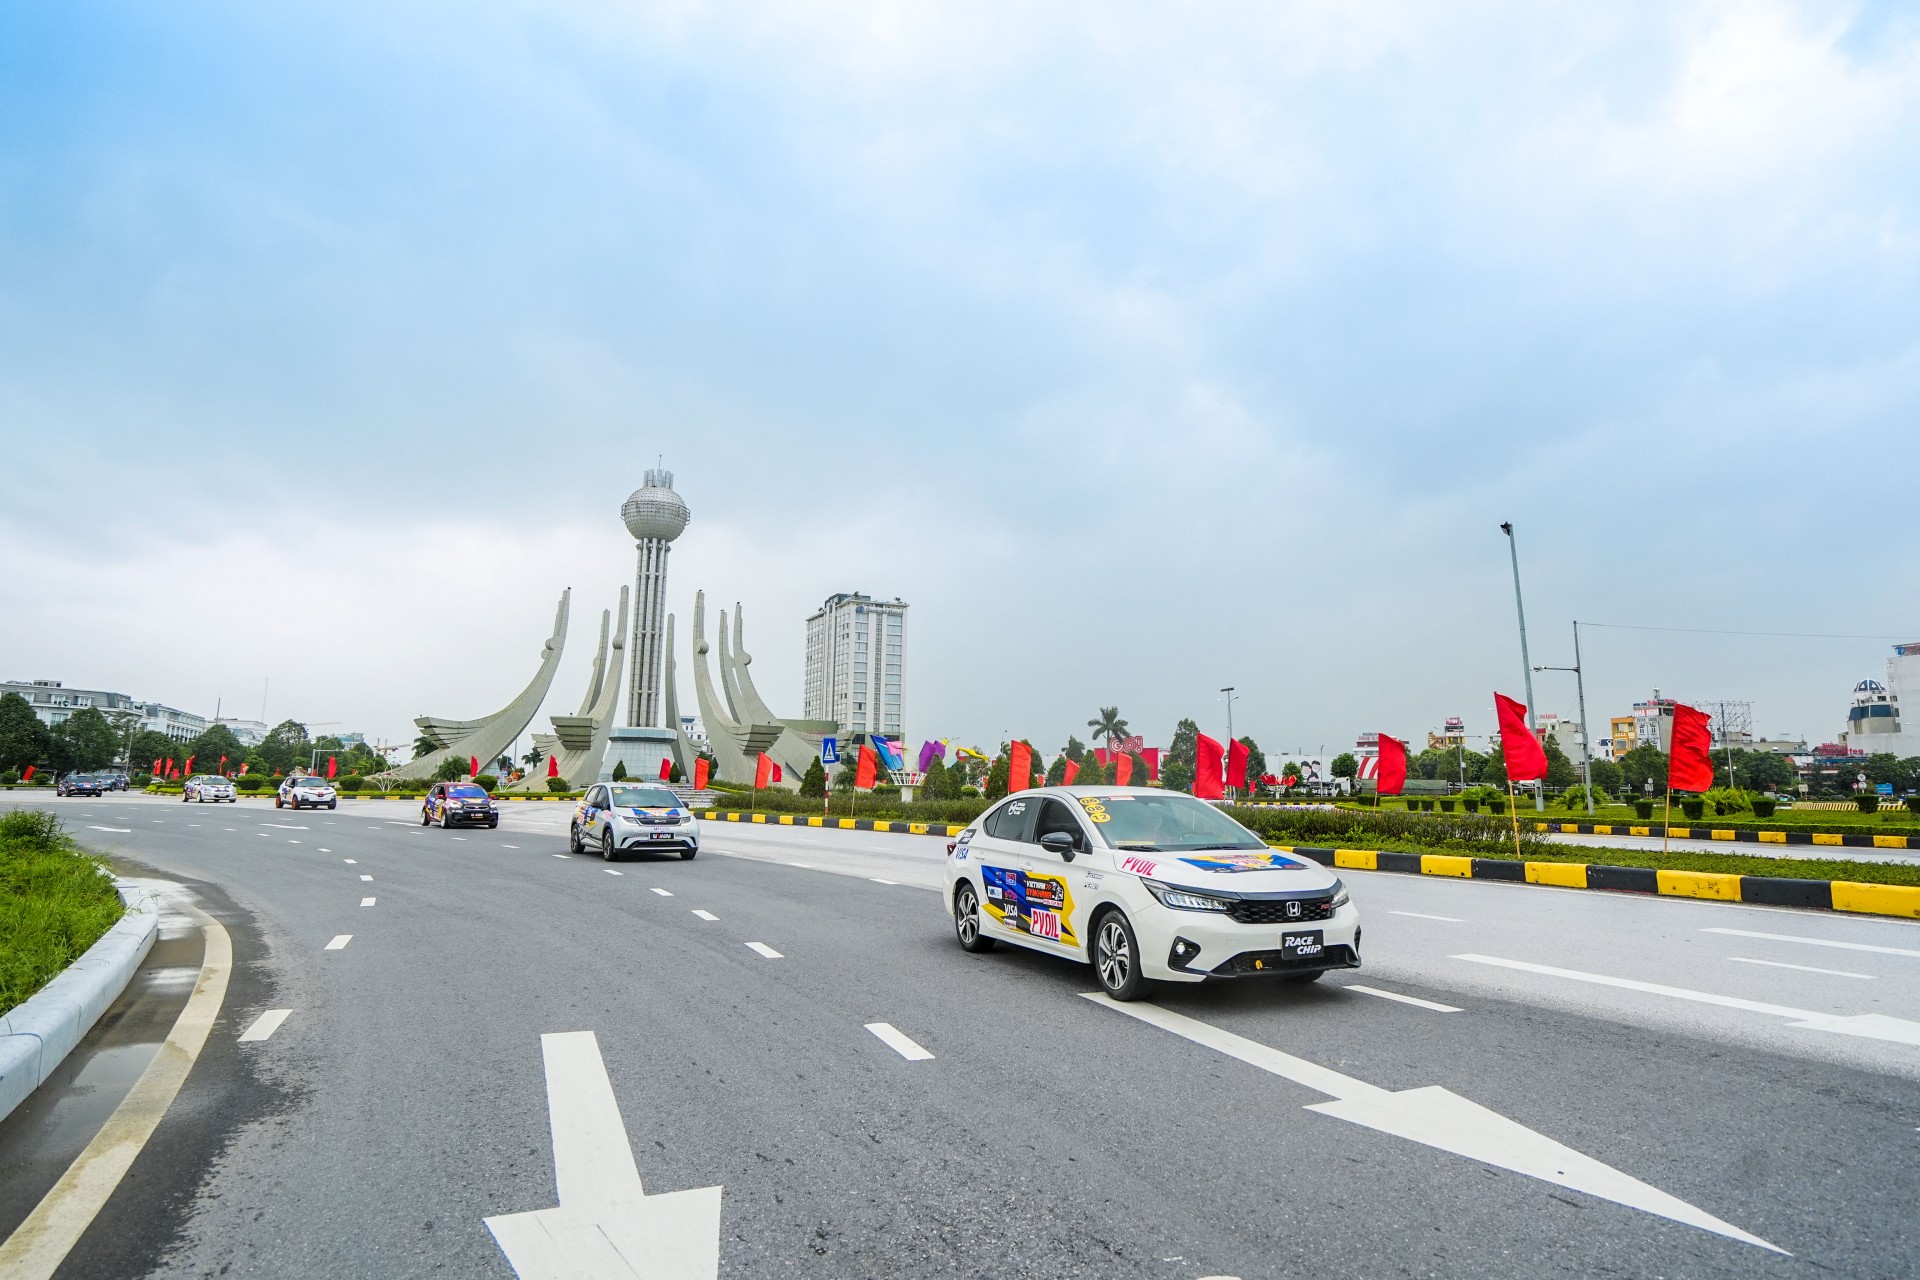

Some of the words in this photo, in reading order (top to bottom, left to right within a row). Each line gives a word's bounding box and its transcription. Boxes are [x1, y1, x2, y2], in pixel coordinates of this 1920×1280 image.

[1110, 736, 1144, 753] GO!
[1121, 856, 1158, 876] PVOIL
[1003, 903, 1018, 917] VISA
[1032, 911, 1059, 938] PVOIL
[1285, 936, 1314, 947] RACE
[1297, 945, 1322, 955] CHIP
